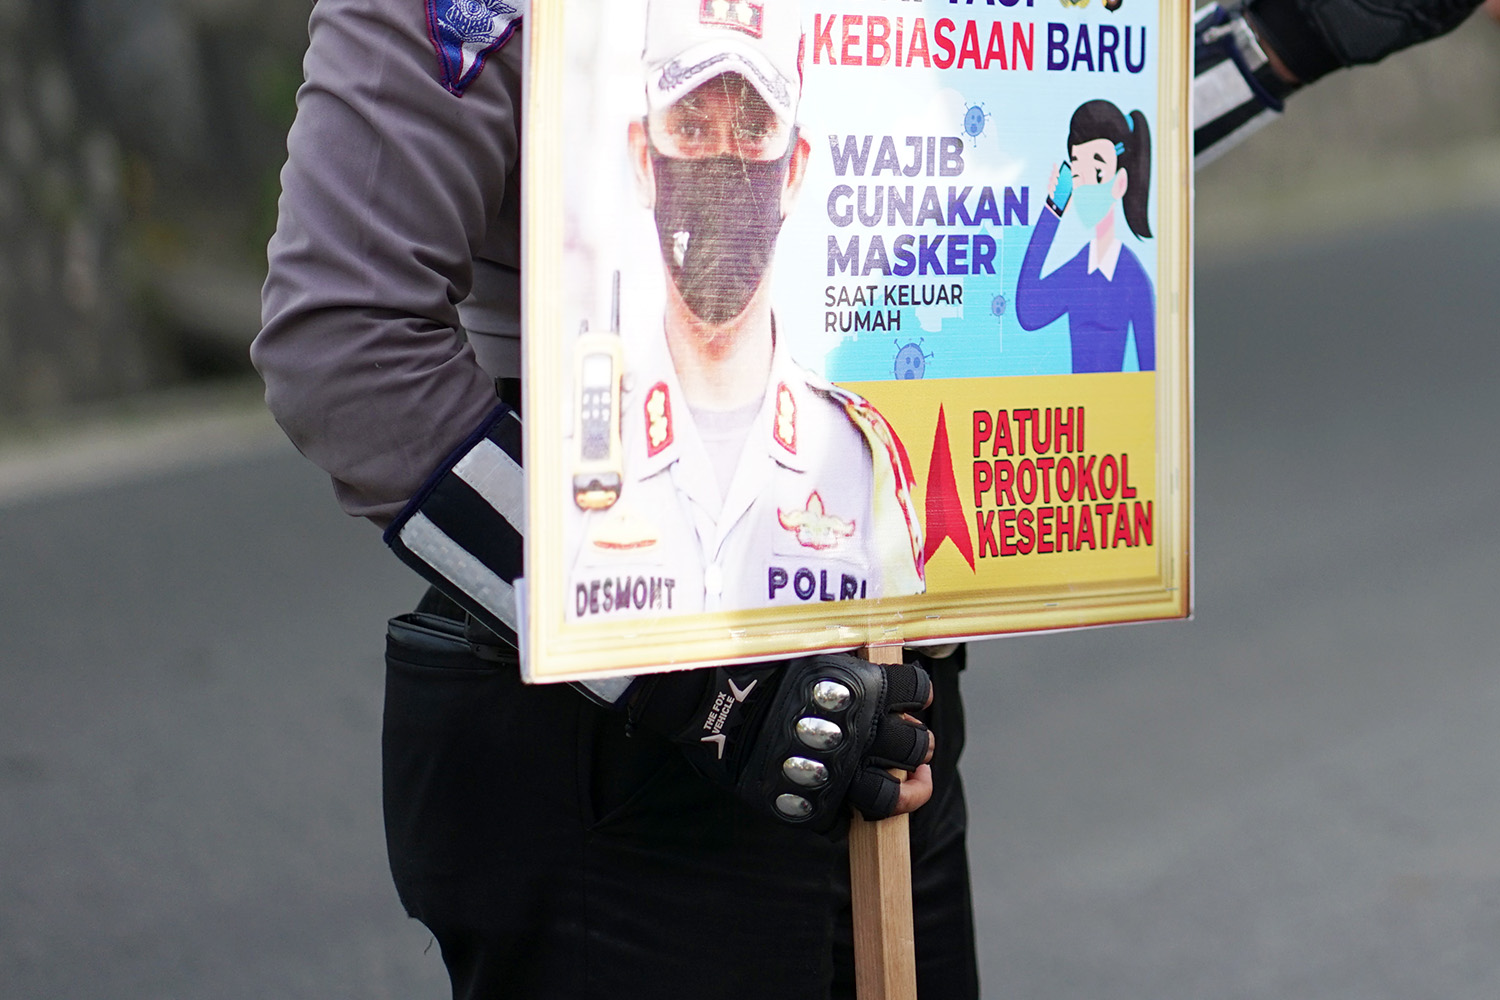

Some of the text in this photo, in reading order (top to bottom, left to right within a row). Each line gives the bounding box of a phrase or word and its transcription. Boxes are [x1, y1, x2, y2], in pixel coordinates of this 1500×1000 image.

[812, 13, 1146, 73] KEBIASAAN BARU
[828, 135, 965, 177] WAJIB
[827, 185, 1029, 227] GUNAKAN
[827, 234, 997, 277] MASKER
[824, 284, 963, 307] SAAT KELUAR
[825, 311, 900, 332] RUMAH
[973, 406, 1084, 457] PATUHI
[973, 453, 1136, 508] PROTOKOL
[976, 501, 1153, 558] KESEHATAN
[768, 566, 866, 601] POLRI
[703, 691, 727, 730] THE FOX
[712, 695, 735, 734] VEHICLE
